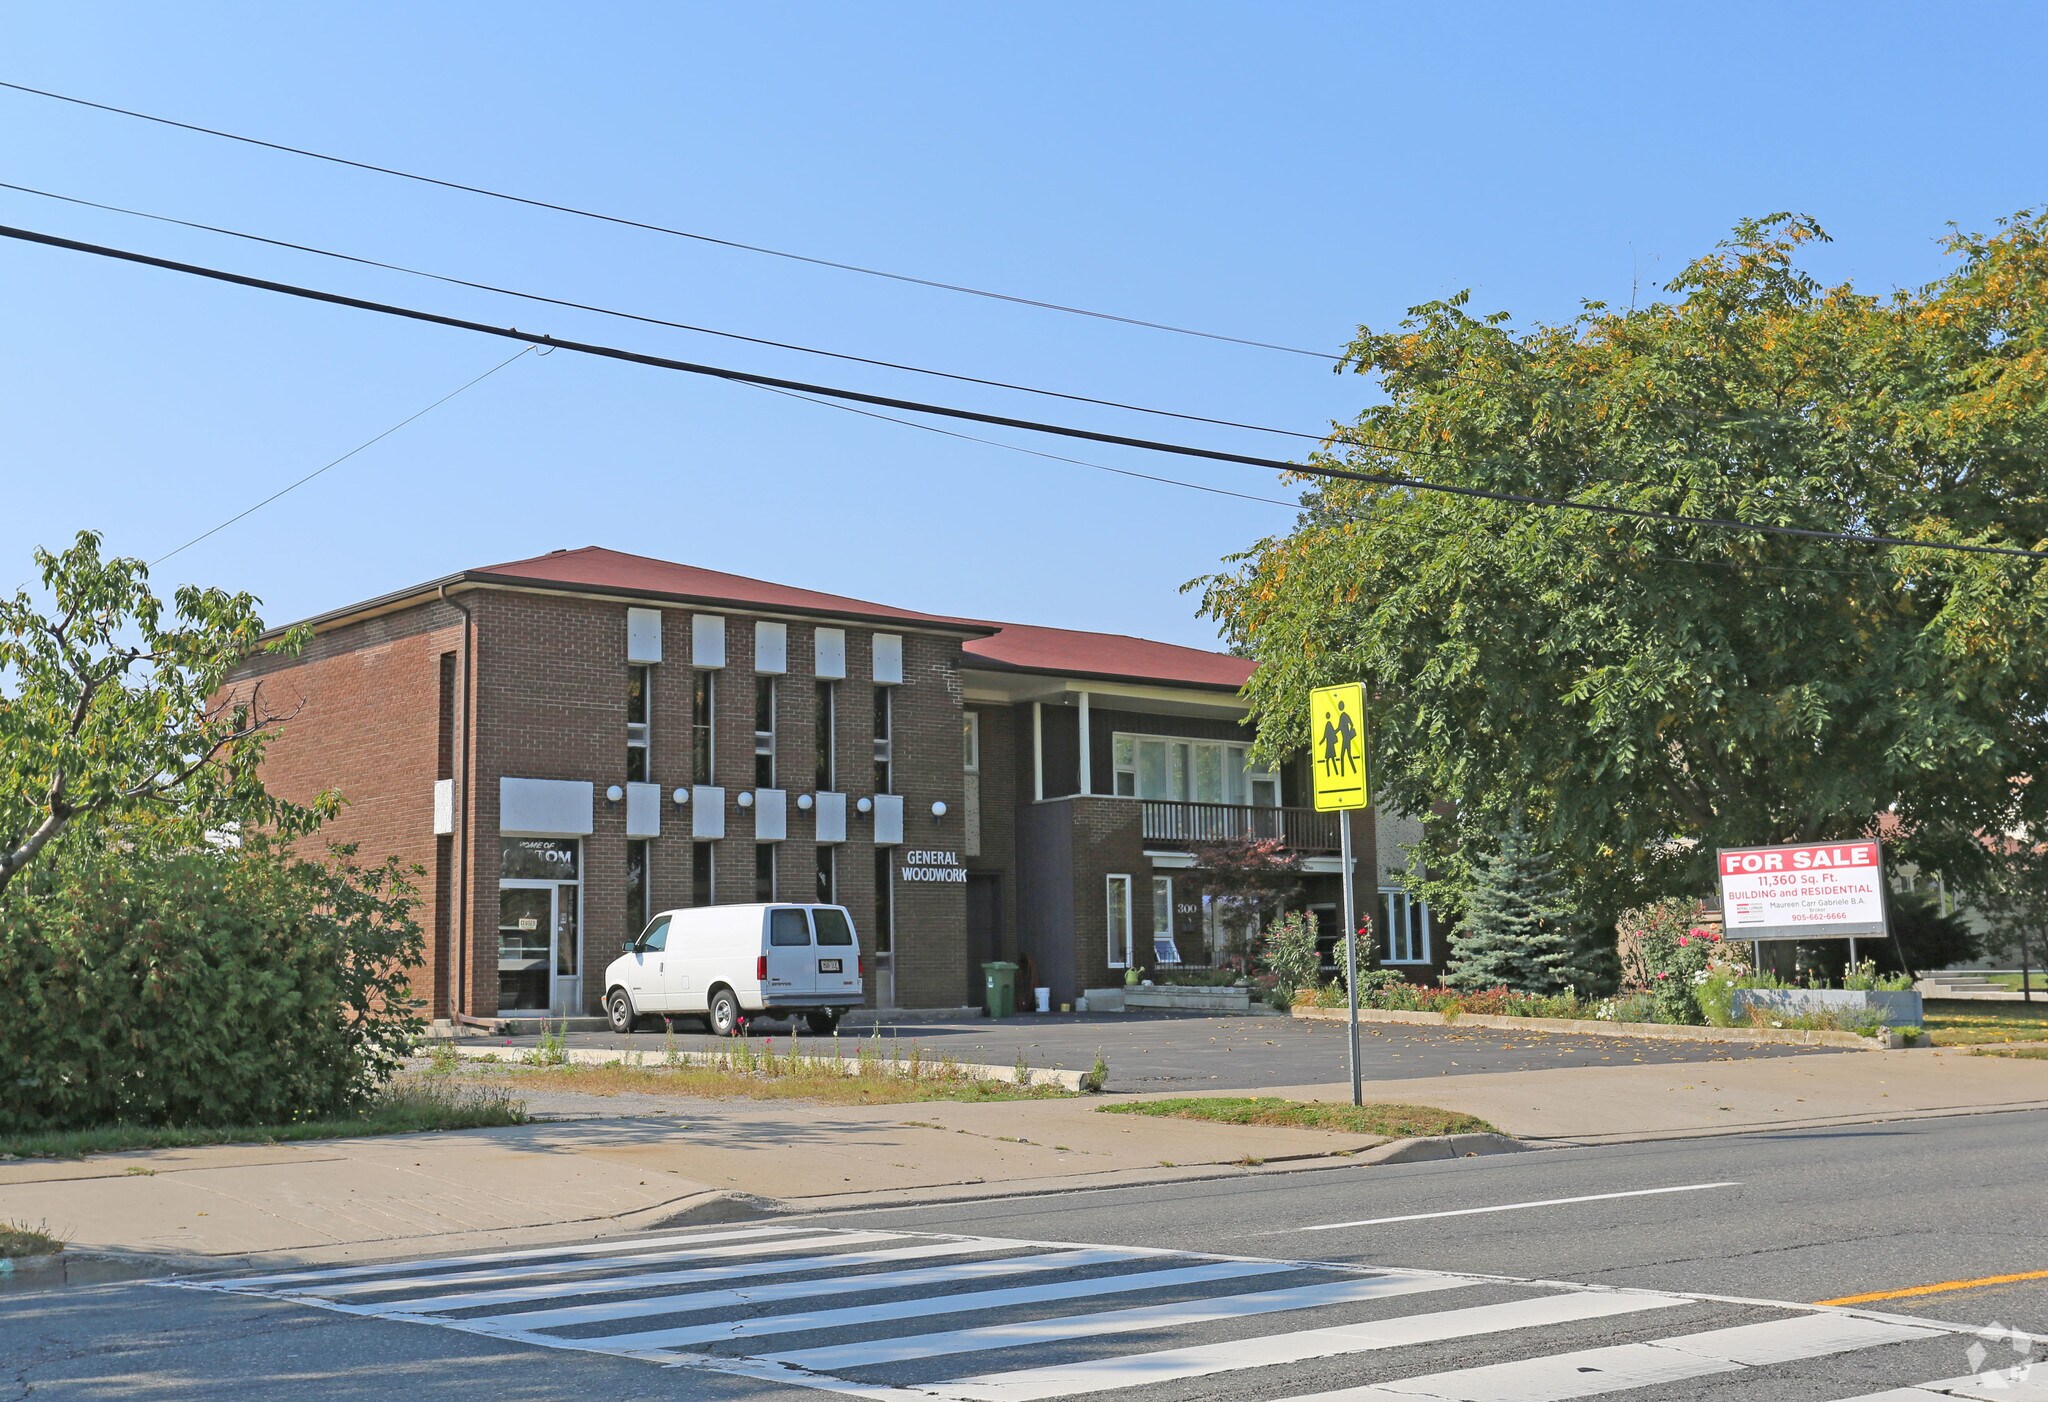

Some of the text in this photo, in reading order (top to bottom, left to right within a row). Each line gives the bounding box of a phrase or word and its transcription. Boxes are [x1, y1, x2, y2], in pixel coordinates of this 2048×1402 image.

[907, 850, 959, 865] GENERAL
[1726, 847, 1870, 873] FOR SALE
[901, 867, 968, 883] WOODWORK
[1758, 873, 1838, 888] 11,360 Sq. Ft.
[1728, 884, 1873, 900] BUILDING and RESIDENTIAL
[1177, 903, 1197, 914] 300
[1769, 901, 1800, 909] Maureen
[1818, 898, 1849, 907] Gabriele
[1850, 897, 1866, 905] B.A.
[1791, 912, 1847, 921] 905-662-6666
